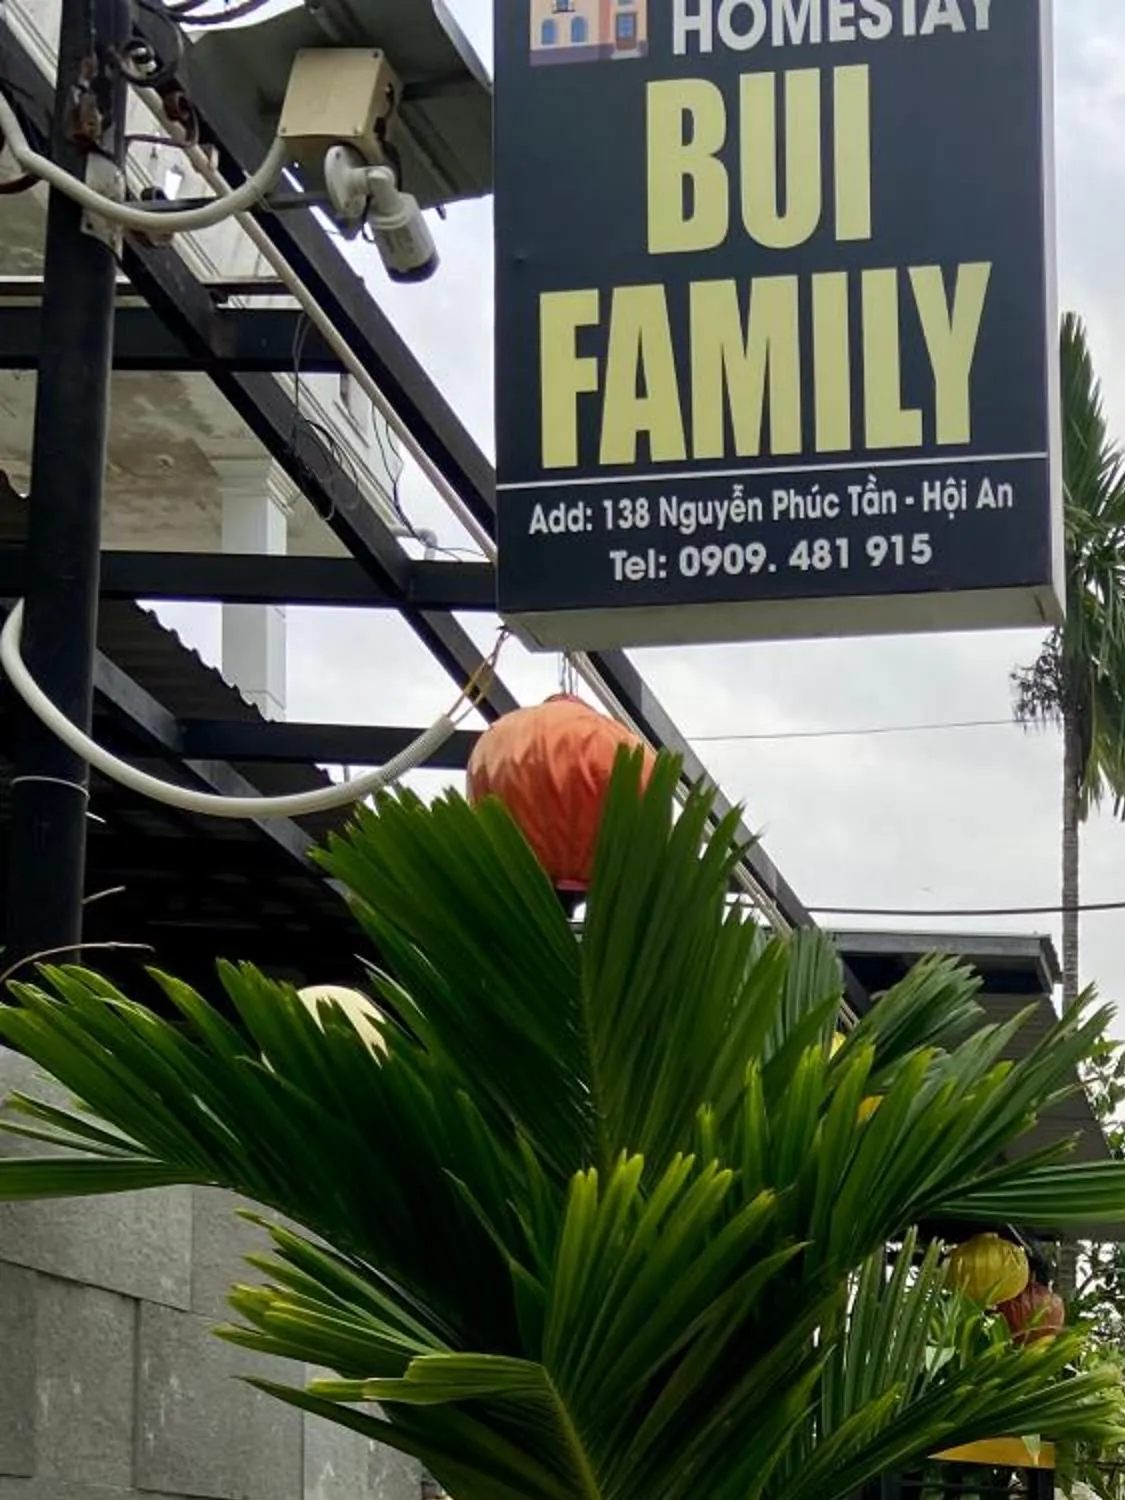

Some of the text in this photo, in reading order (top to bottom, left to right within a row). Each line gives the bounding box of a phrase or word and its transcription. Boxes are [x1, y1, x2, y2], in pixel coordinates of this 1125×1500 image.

[646, 64, 872, 255] BUI
[540, 262, 992, 469] FAMILY
[529, 501, 593, 535] Add:
[603, 497, 650, 530] 138
[659, 484, 763, 535] Nguyễn
[772, 484, 840, 521] Phúc
[847, 473, 897, 517] Tần
[922, 477, 967, 520] Hội
[975, 477, 1013, 509] An
[609, 533, 932, 581] Tel: 0909. 481 915
